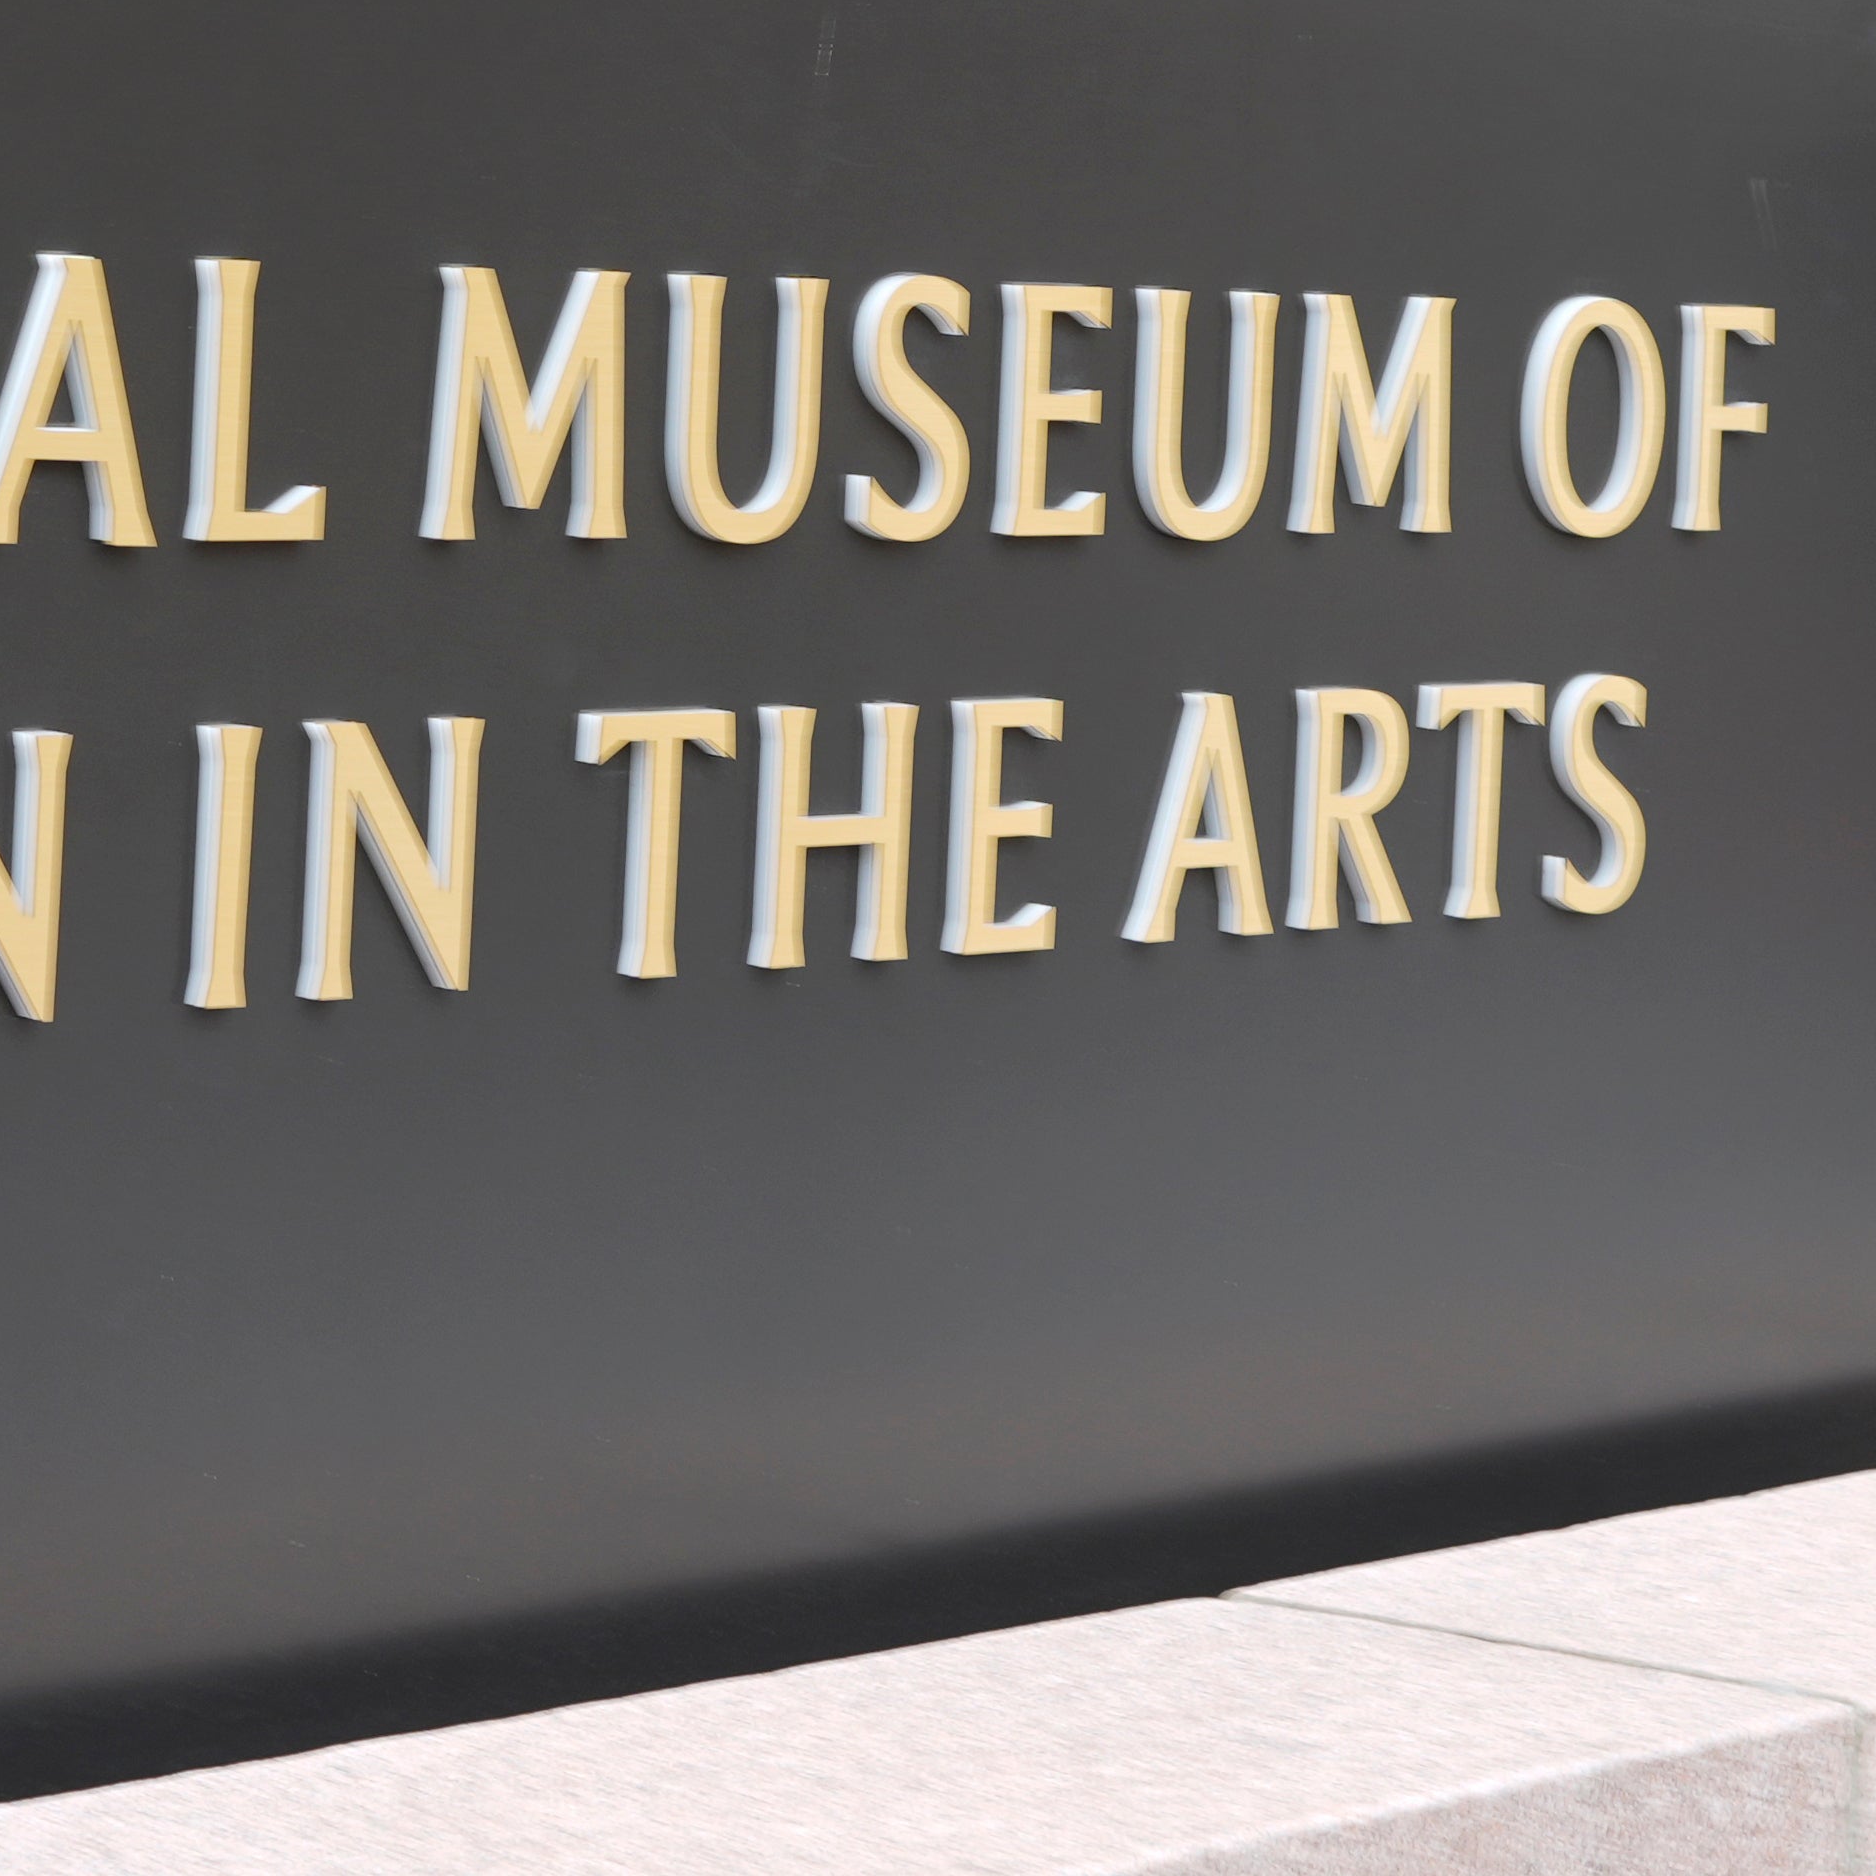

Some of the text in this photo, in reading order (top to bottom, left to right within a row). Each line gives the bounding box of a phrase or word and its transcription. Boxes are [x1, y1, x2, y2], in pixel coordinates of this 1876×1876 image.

[419, 264, 1457, 544] MUSEUM
[1520, 294, 1775, 538] OF
[184, 716, 485, 1009] IN
[575, 696, 1064, 979] THE
[1120, 672, 1647, 943] ARTS
